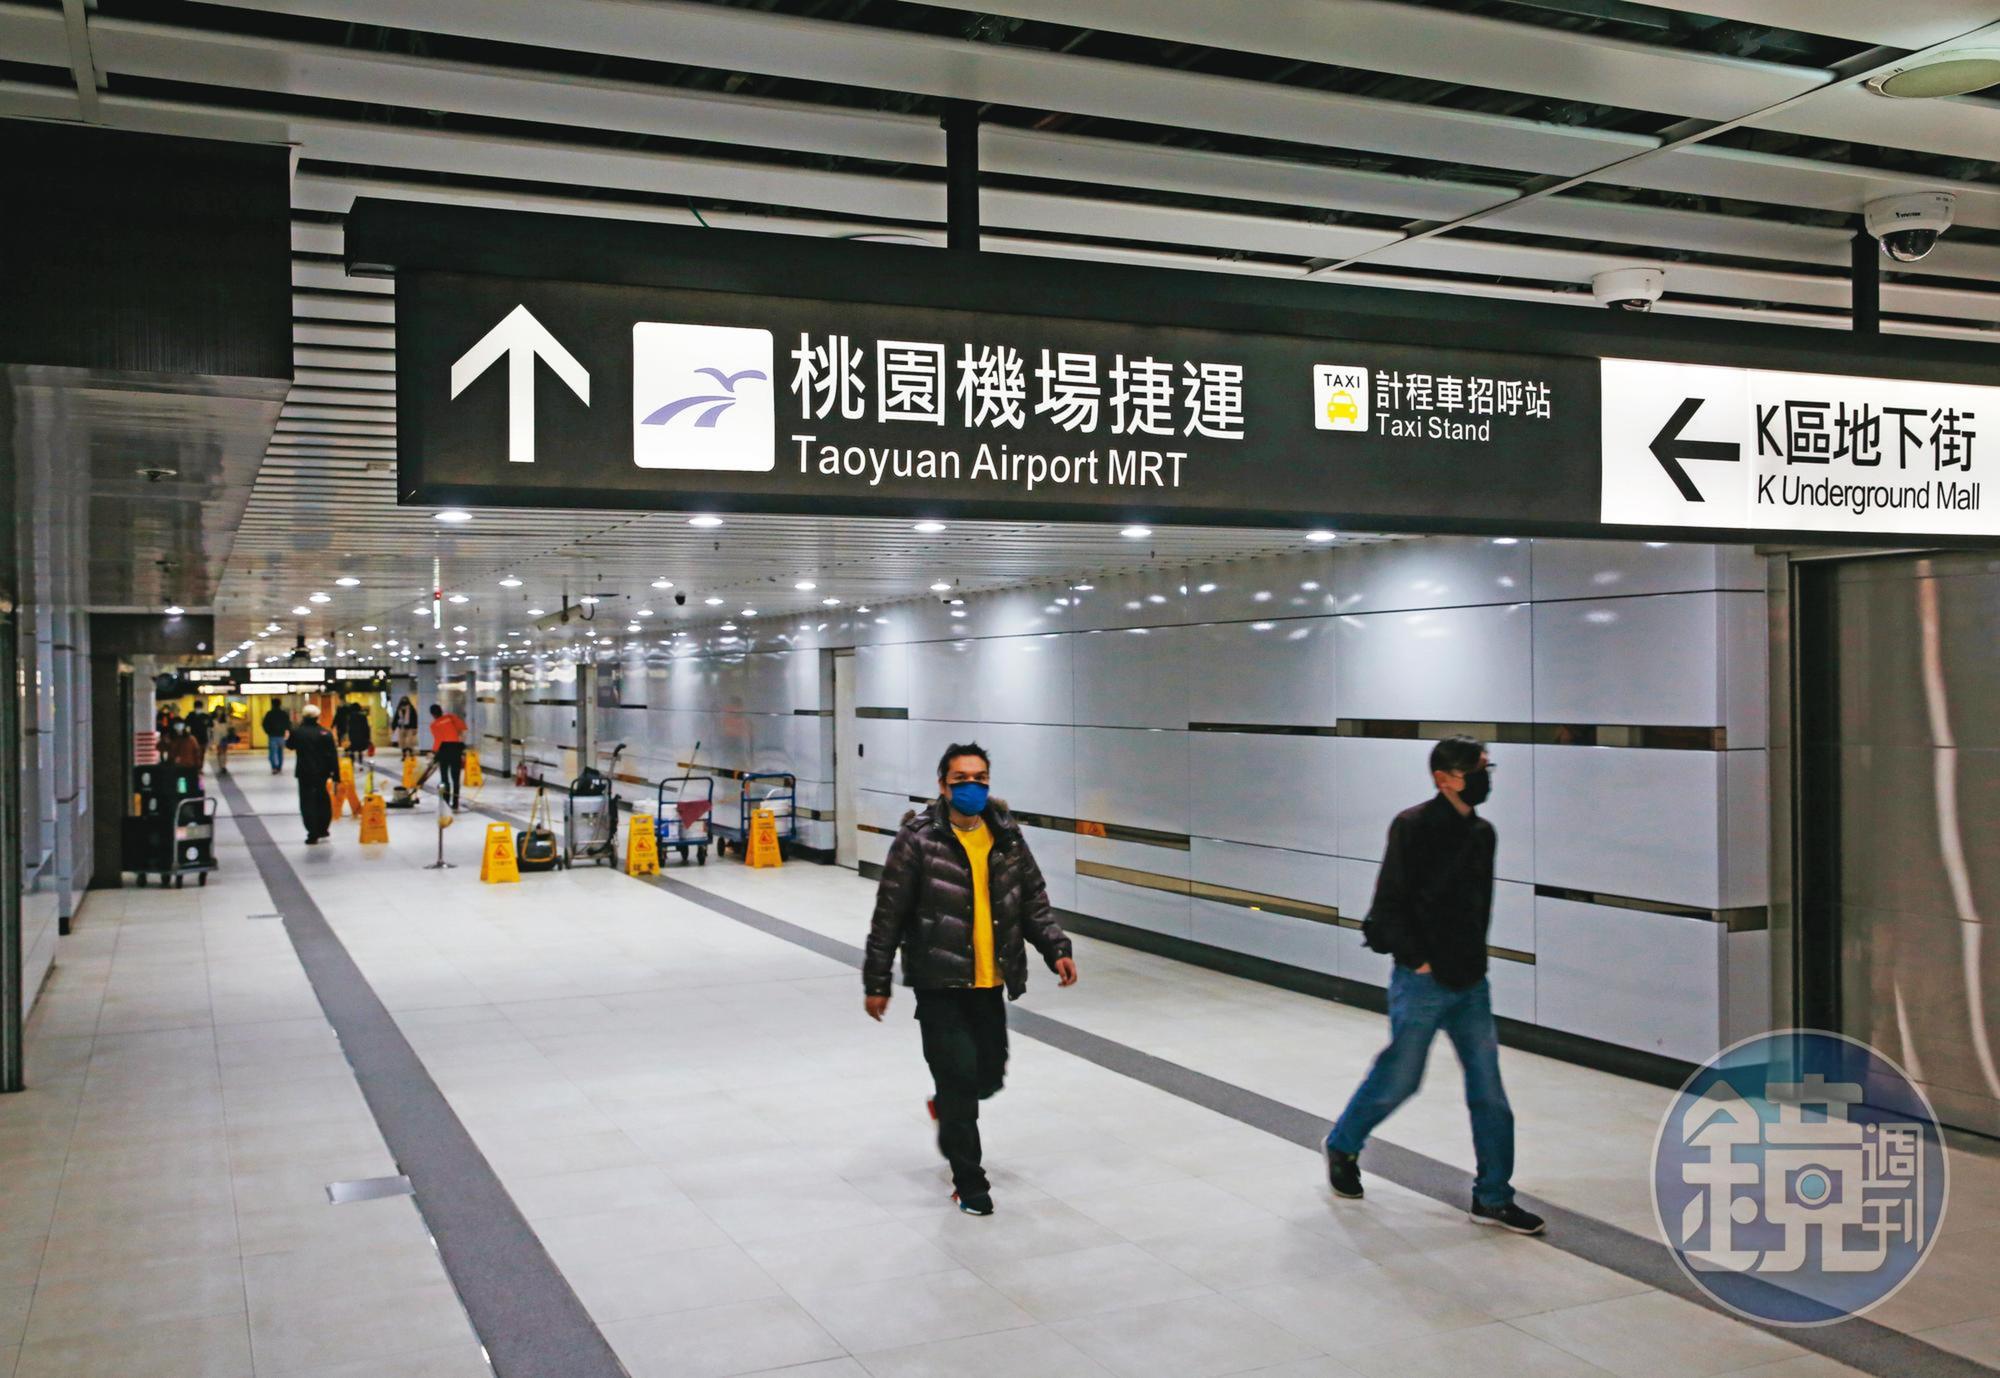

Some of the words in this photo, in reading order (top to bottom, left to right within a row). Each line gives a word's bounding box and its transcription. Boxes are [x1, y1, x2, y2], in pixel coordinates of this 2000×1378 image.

[790, 332, 1245, 440] 桃園機場捷運
[1323, 373, 1360, 389] TAXI
[1375, 370, 1552, 419] 計程車招呼站
[1375, 413, 1422, 438] Taxi
[1428, 416, 1490, 442] Stand
[1756, 399, 1977, 472] K區地下街
[791, 434, 961, 486] Taoyuan
[970, 443, 1100, 491] Airport
[1108, 449, 1188, 487] MRT
[1757, 474, 1777, 505] K
[1782, 475, 1931, 515] Underground
[1937, 481, 1981, 510] Mall
